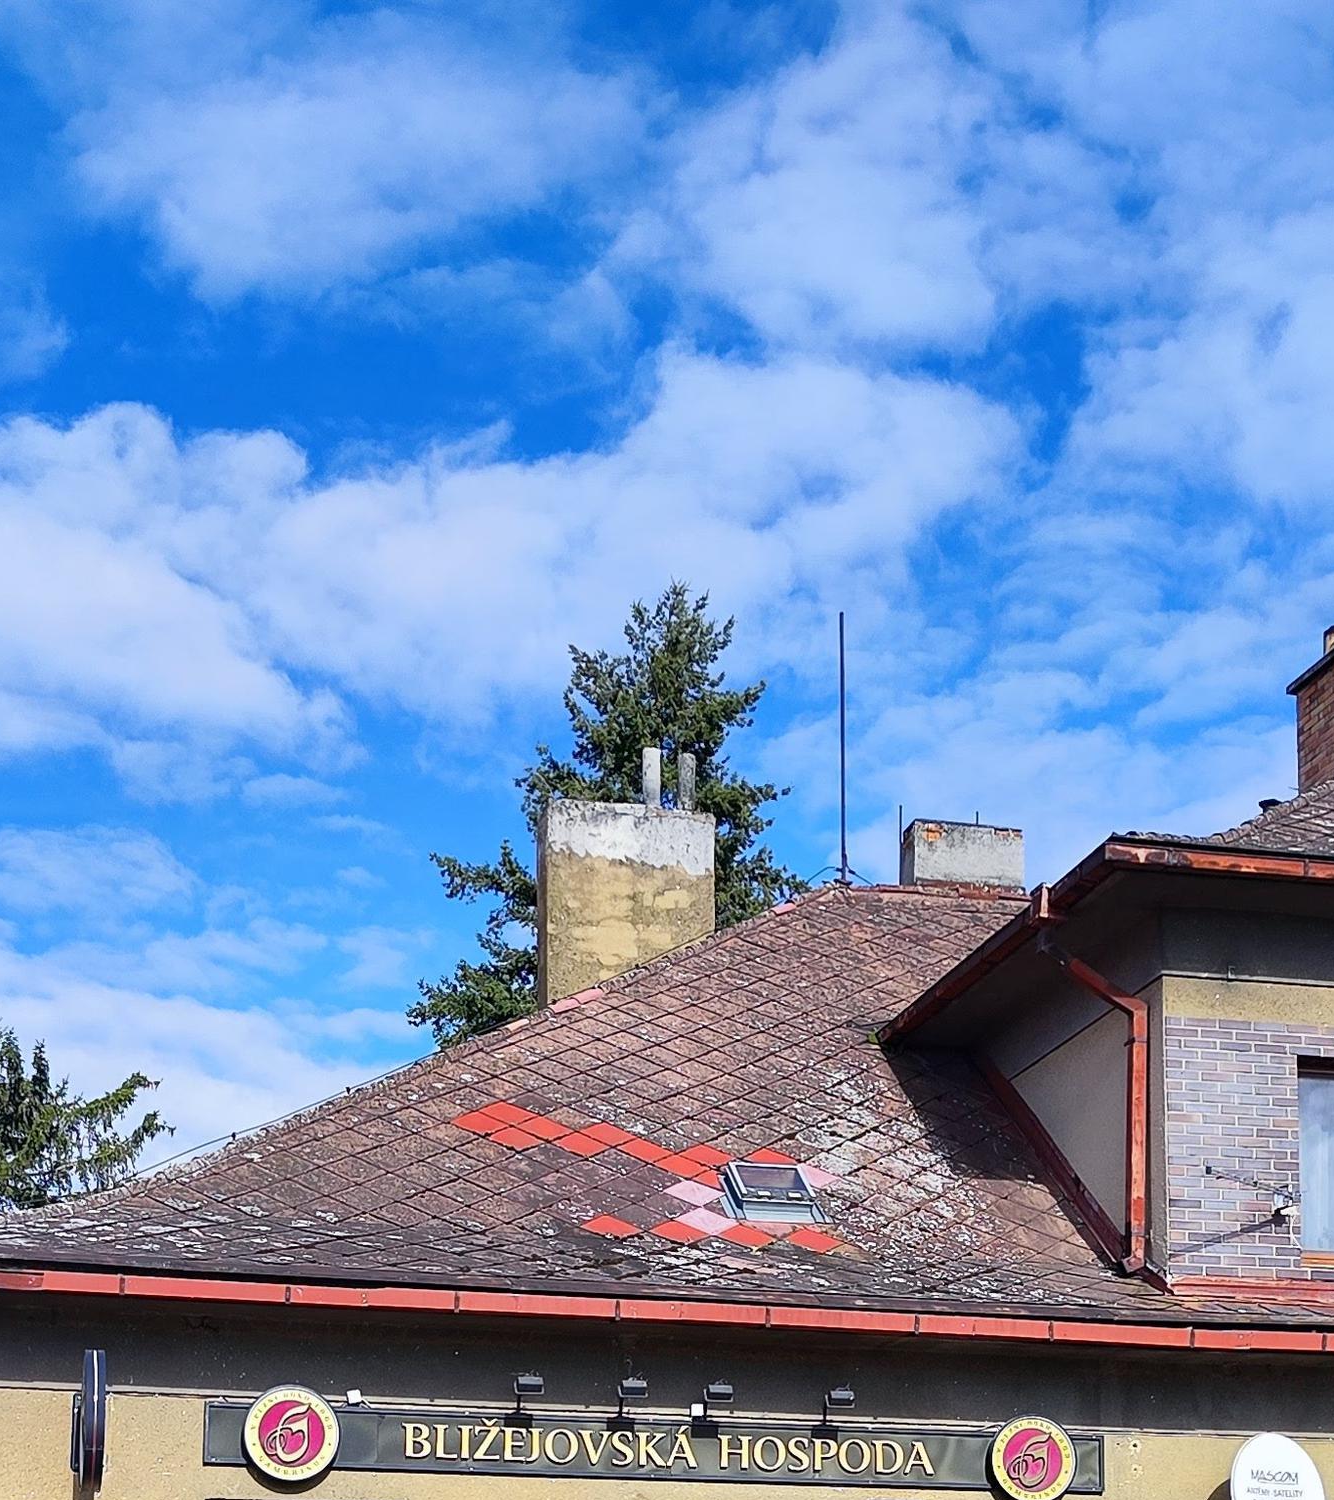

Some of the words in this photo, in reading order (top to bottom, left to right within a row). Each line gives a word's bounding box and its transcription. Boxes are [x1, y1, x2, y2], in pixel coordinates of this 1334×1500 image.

[401, 1418, 698, 1469] BLIŽEJOVSKÁ
[718, 1434, 936, 1477] HOSPODA
[1251, 1469, 1299, 1485] MASCOM
